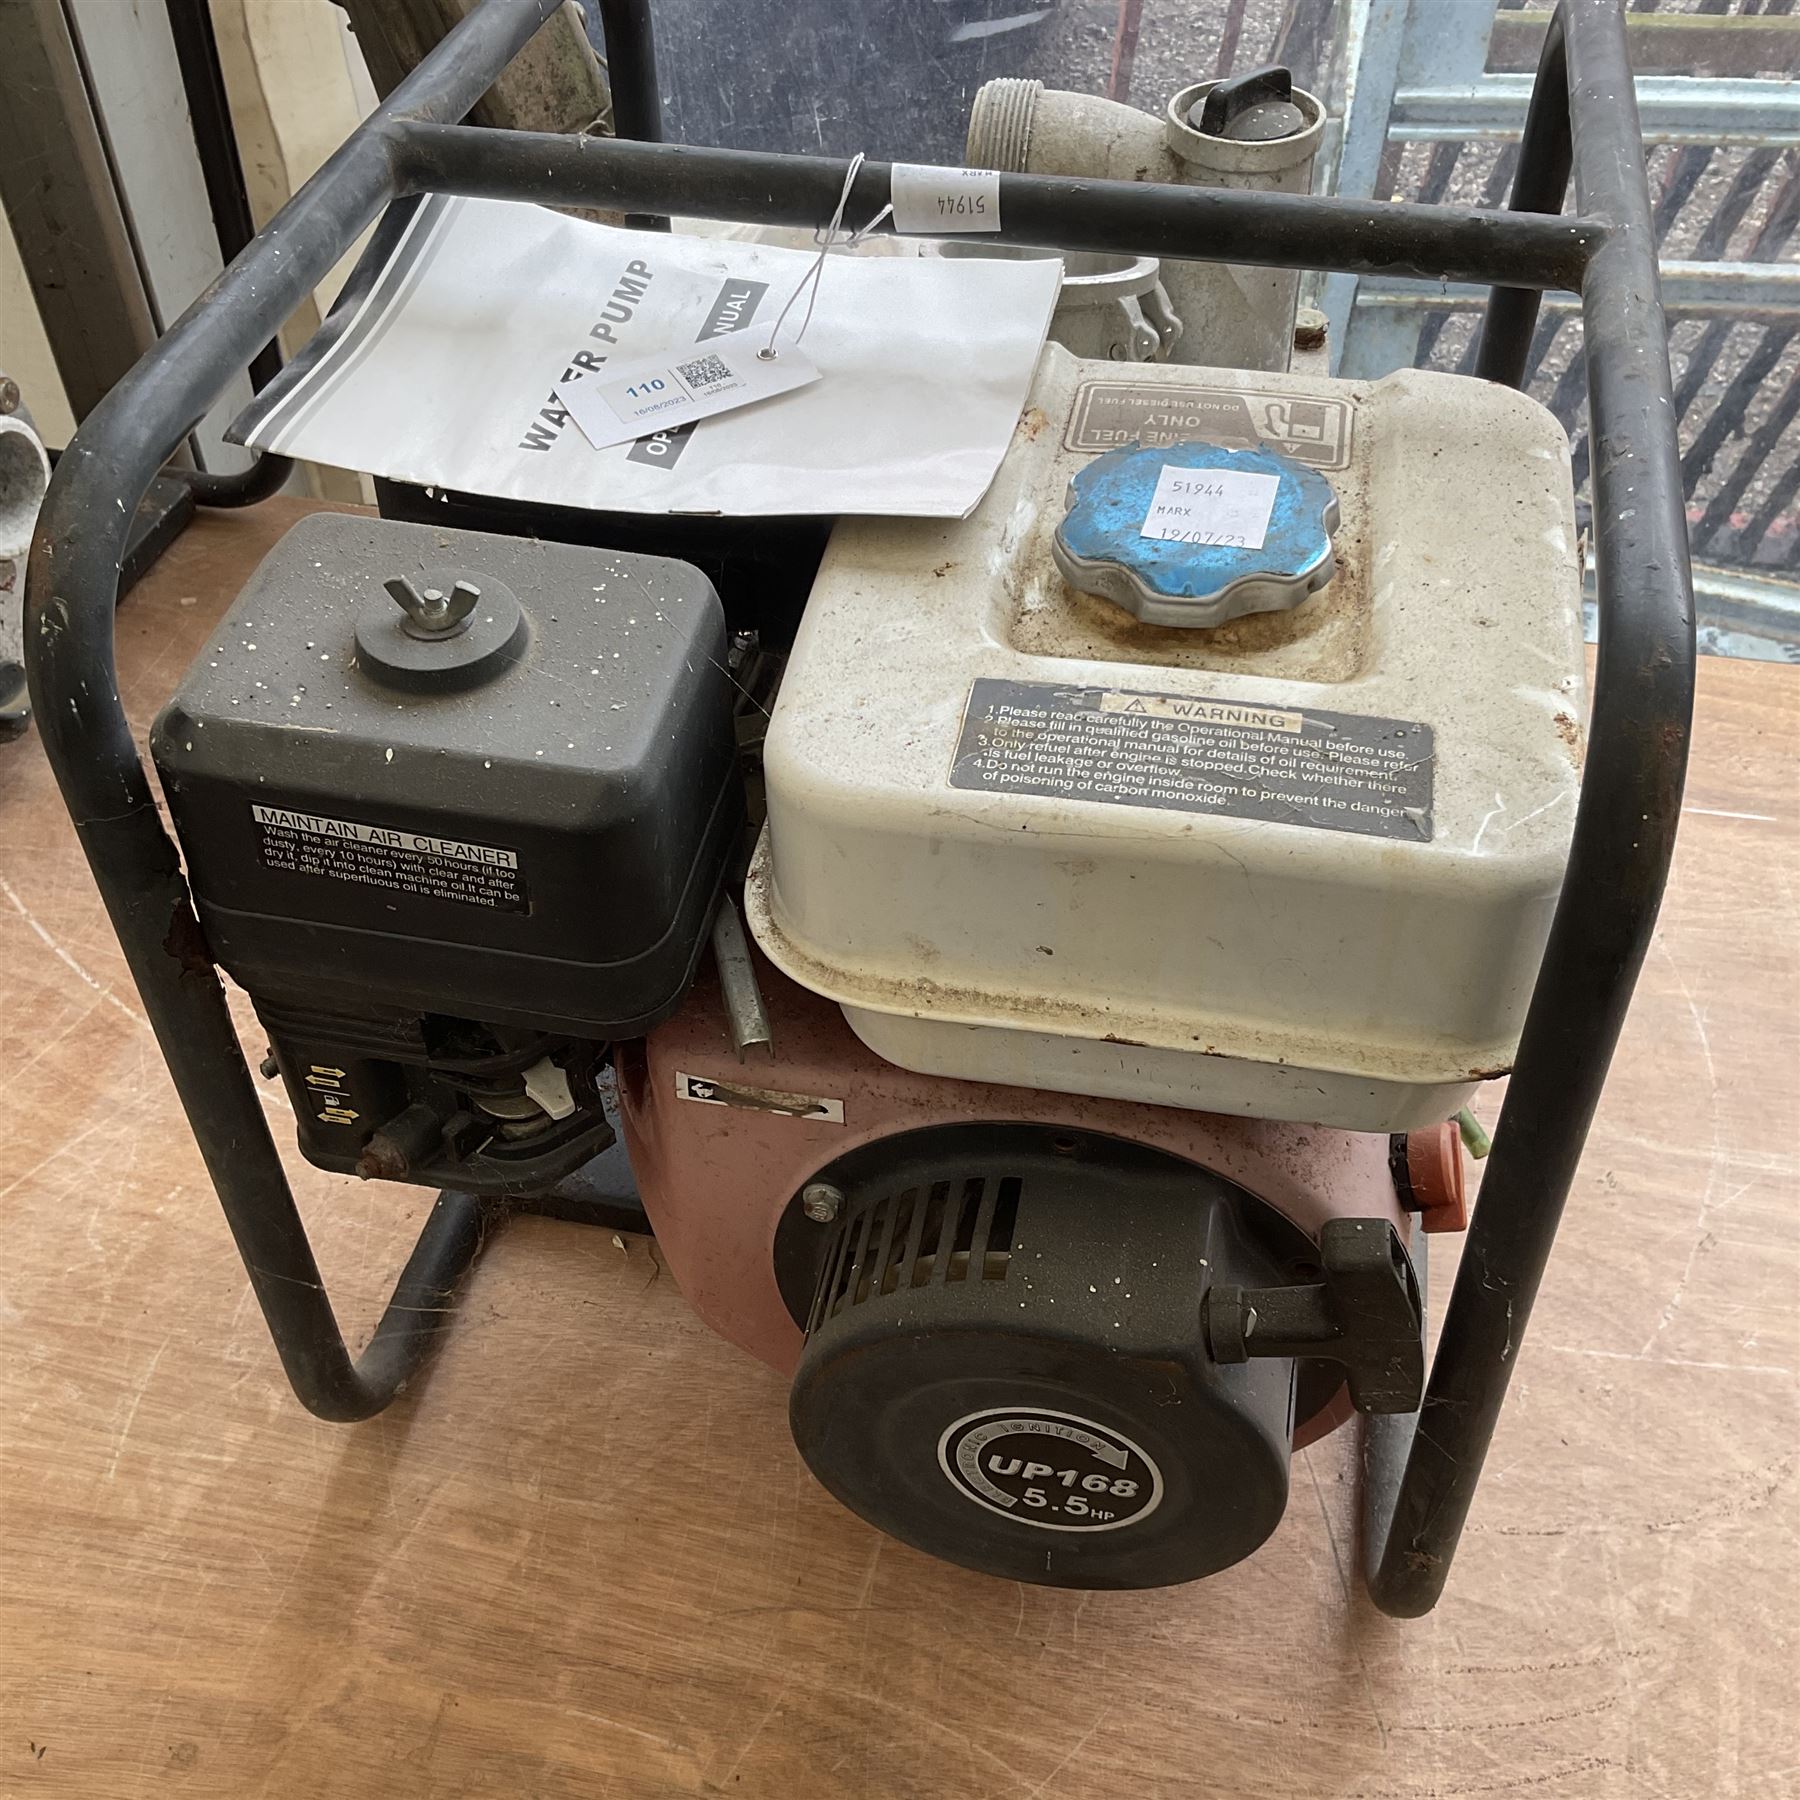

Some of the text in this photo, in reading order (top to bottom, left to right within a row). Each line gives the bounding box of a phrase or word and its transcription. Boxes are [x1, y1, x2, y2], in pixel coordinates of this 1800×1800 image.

[938, 195, 985, 215] 51944
[589, 259, 654, 344] PUMP
[713, 290, 751, 334] NUAL
[626, 379, 665, 398] 110
[1098, 397, 1126, 405] FUEL
[1130, 397, 1169, 407] DIESEL
[634, 396, 687, 417] 16/08/2023
[1144, 414, 1200, 427] ONLY
[1197, 402, 1220, 411] NOT
[1222, 404, 1240, 412] DO
[1091, 429, 1140, 441] FUEL
[1172, 481, 1224, 496] 51944
[1156, 506, 1191, 516] MARX
[1161, 528, 1245, 548] 19/07/23
[1173, 703, 1285, 727] WARNING
[1049, 720, 1066, 731] fill
[1068, 722, 1082, 732] in
[1085, 725, 1148, 739] qualified
[1152, 732, 1215, 746] gasoline
[1218, 739, 1237, 749] oil
[1240, 740, 1289, 755] before
[1292, 748, 1324, 760] use.
[1329, 751, 1380, 767] Please
[1383, 760, 1419, 773] refer
[1087, 715, 1148, 729] carefully
[1151, 720, 1174, 731] the
[1178, 722, 1264, 741] Operational
[1267, 732, 1322, 748] Manual
[1326, 740, 1375, 755] before
[1378, 748, 1409, 760] use.
[993, 727, 1397, 781] to the operational manual for details of oil requirement.
[1004, 749, 1032, 761] fuel
[1034, 752, 1093, 768] leakage
[1096, 760, 1114, 769] or
[1116, 762, 1183, 777] overflow.
[1029, 742, 1071, 754] refuel
[1073, 746, 1108, 758] after
[1110, 750, 1161, 764] engine
[1164, 754, 1178, 766] is
[1301, 772, 1364, 788] whether
[1367, 780, 1407, 795] there
[982, 770, 1230, 806] of poisoning of carbon monoxide.
[1011, 763, 1035, 773] not
[1038, 765, 1063, 776] run
[1066, 766, 1090, 778] the
[1093, 771, 1145, 784] engine
[1148, 775, 1194, 790] inside
[1197, 783, 1238, 795] room
[1241, 786, 1257, 798] to
[1260, 790, 1319, 806] prevent
[1322, 796, 1347, 810] the
[1350, 801, 1408, 818] danger
[261, 808, 511, 867] MAINTAIN AIR CLEANER
[263, 825, 516, 880] Wash the air cleaner every 50 hours (if too
[264, 848, 283, 859] dry
[300, 854, 320, 866] dip
[323, 858, 330, 867] it
[333, 859, 356, 871] into
[359, 865, 392, 877] clean
[395, 872, 448, 888] machine
[479, 886, 502, 898] can
[504, 890, 520, 902] be
[303, 845, 336, 859] every
[340, 850, 355, 861] 10
[357, 854, 397, 870] hours)
[400, 862, 426, 874] with
[428, 867, 459, 880] clear
[462, 873, 485, 885] and
[488, 878, 515, 890] after
[266, 859, 498, 907] used after superfluous oil is eliminated.
[999, 1422, 1107, 1451] IGNITION
[988, 1455, 1140, 1498] UP168
